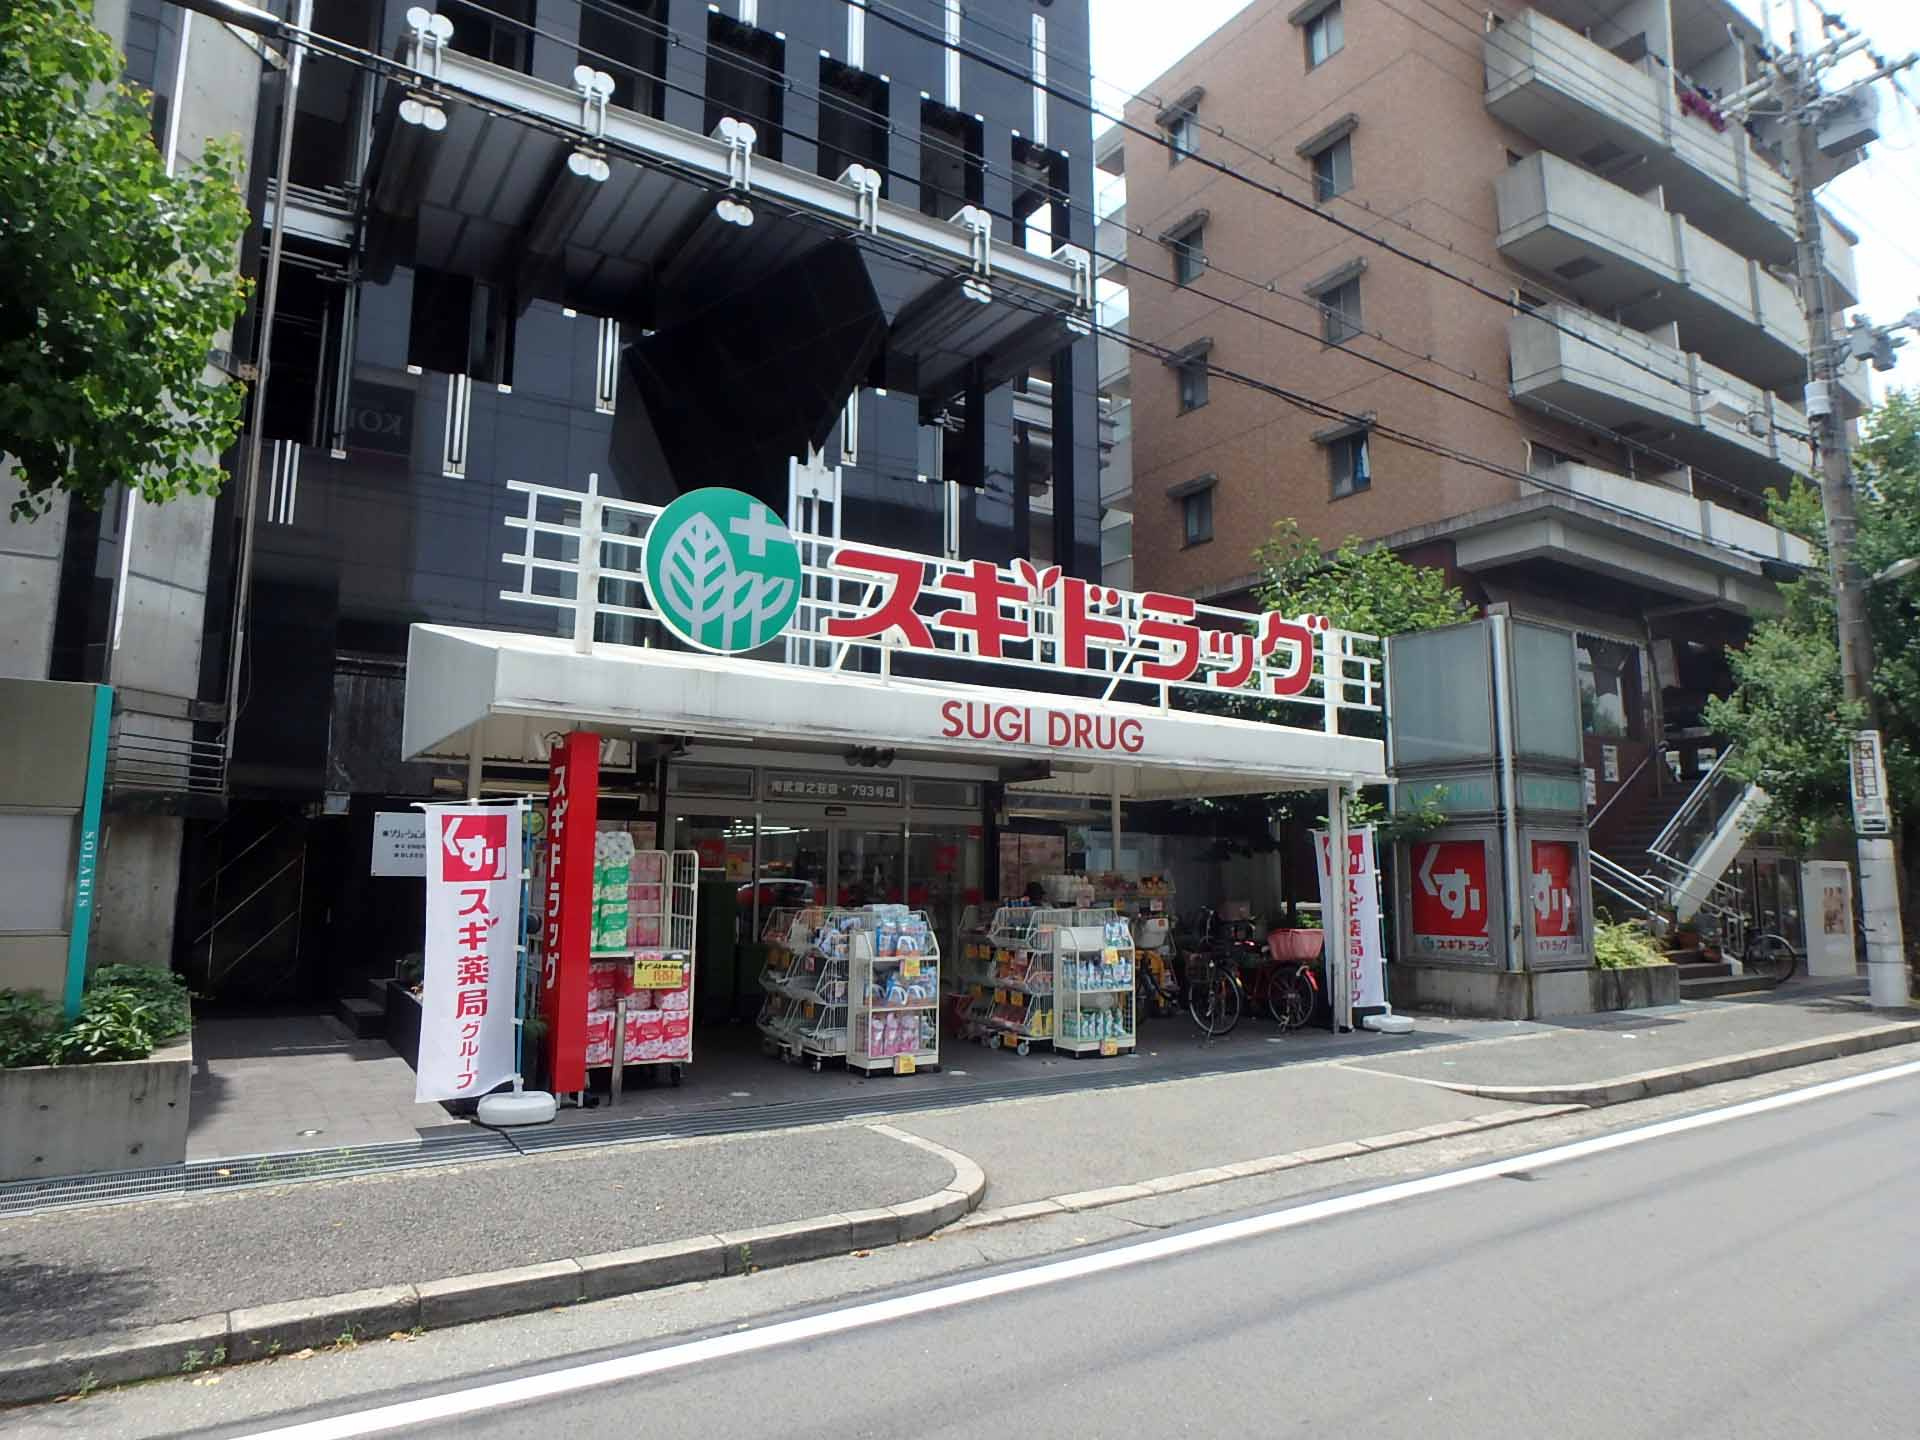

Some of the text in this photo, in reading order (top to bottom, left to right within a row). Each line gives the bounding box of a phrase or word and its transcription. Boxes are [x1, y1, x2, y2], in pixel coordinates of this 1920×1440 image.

[826, 549, 1331, 696] スギドラッグ
[942, 700, 1145, 754] SUGI DRUG
[79, 831, 96, 908] SOLARIS
[442, 816, 507, 879] くすり
[545, 765, 569, 989] スギドラッグ
